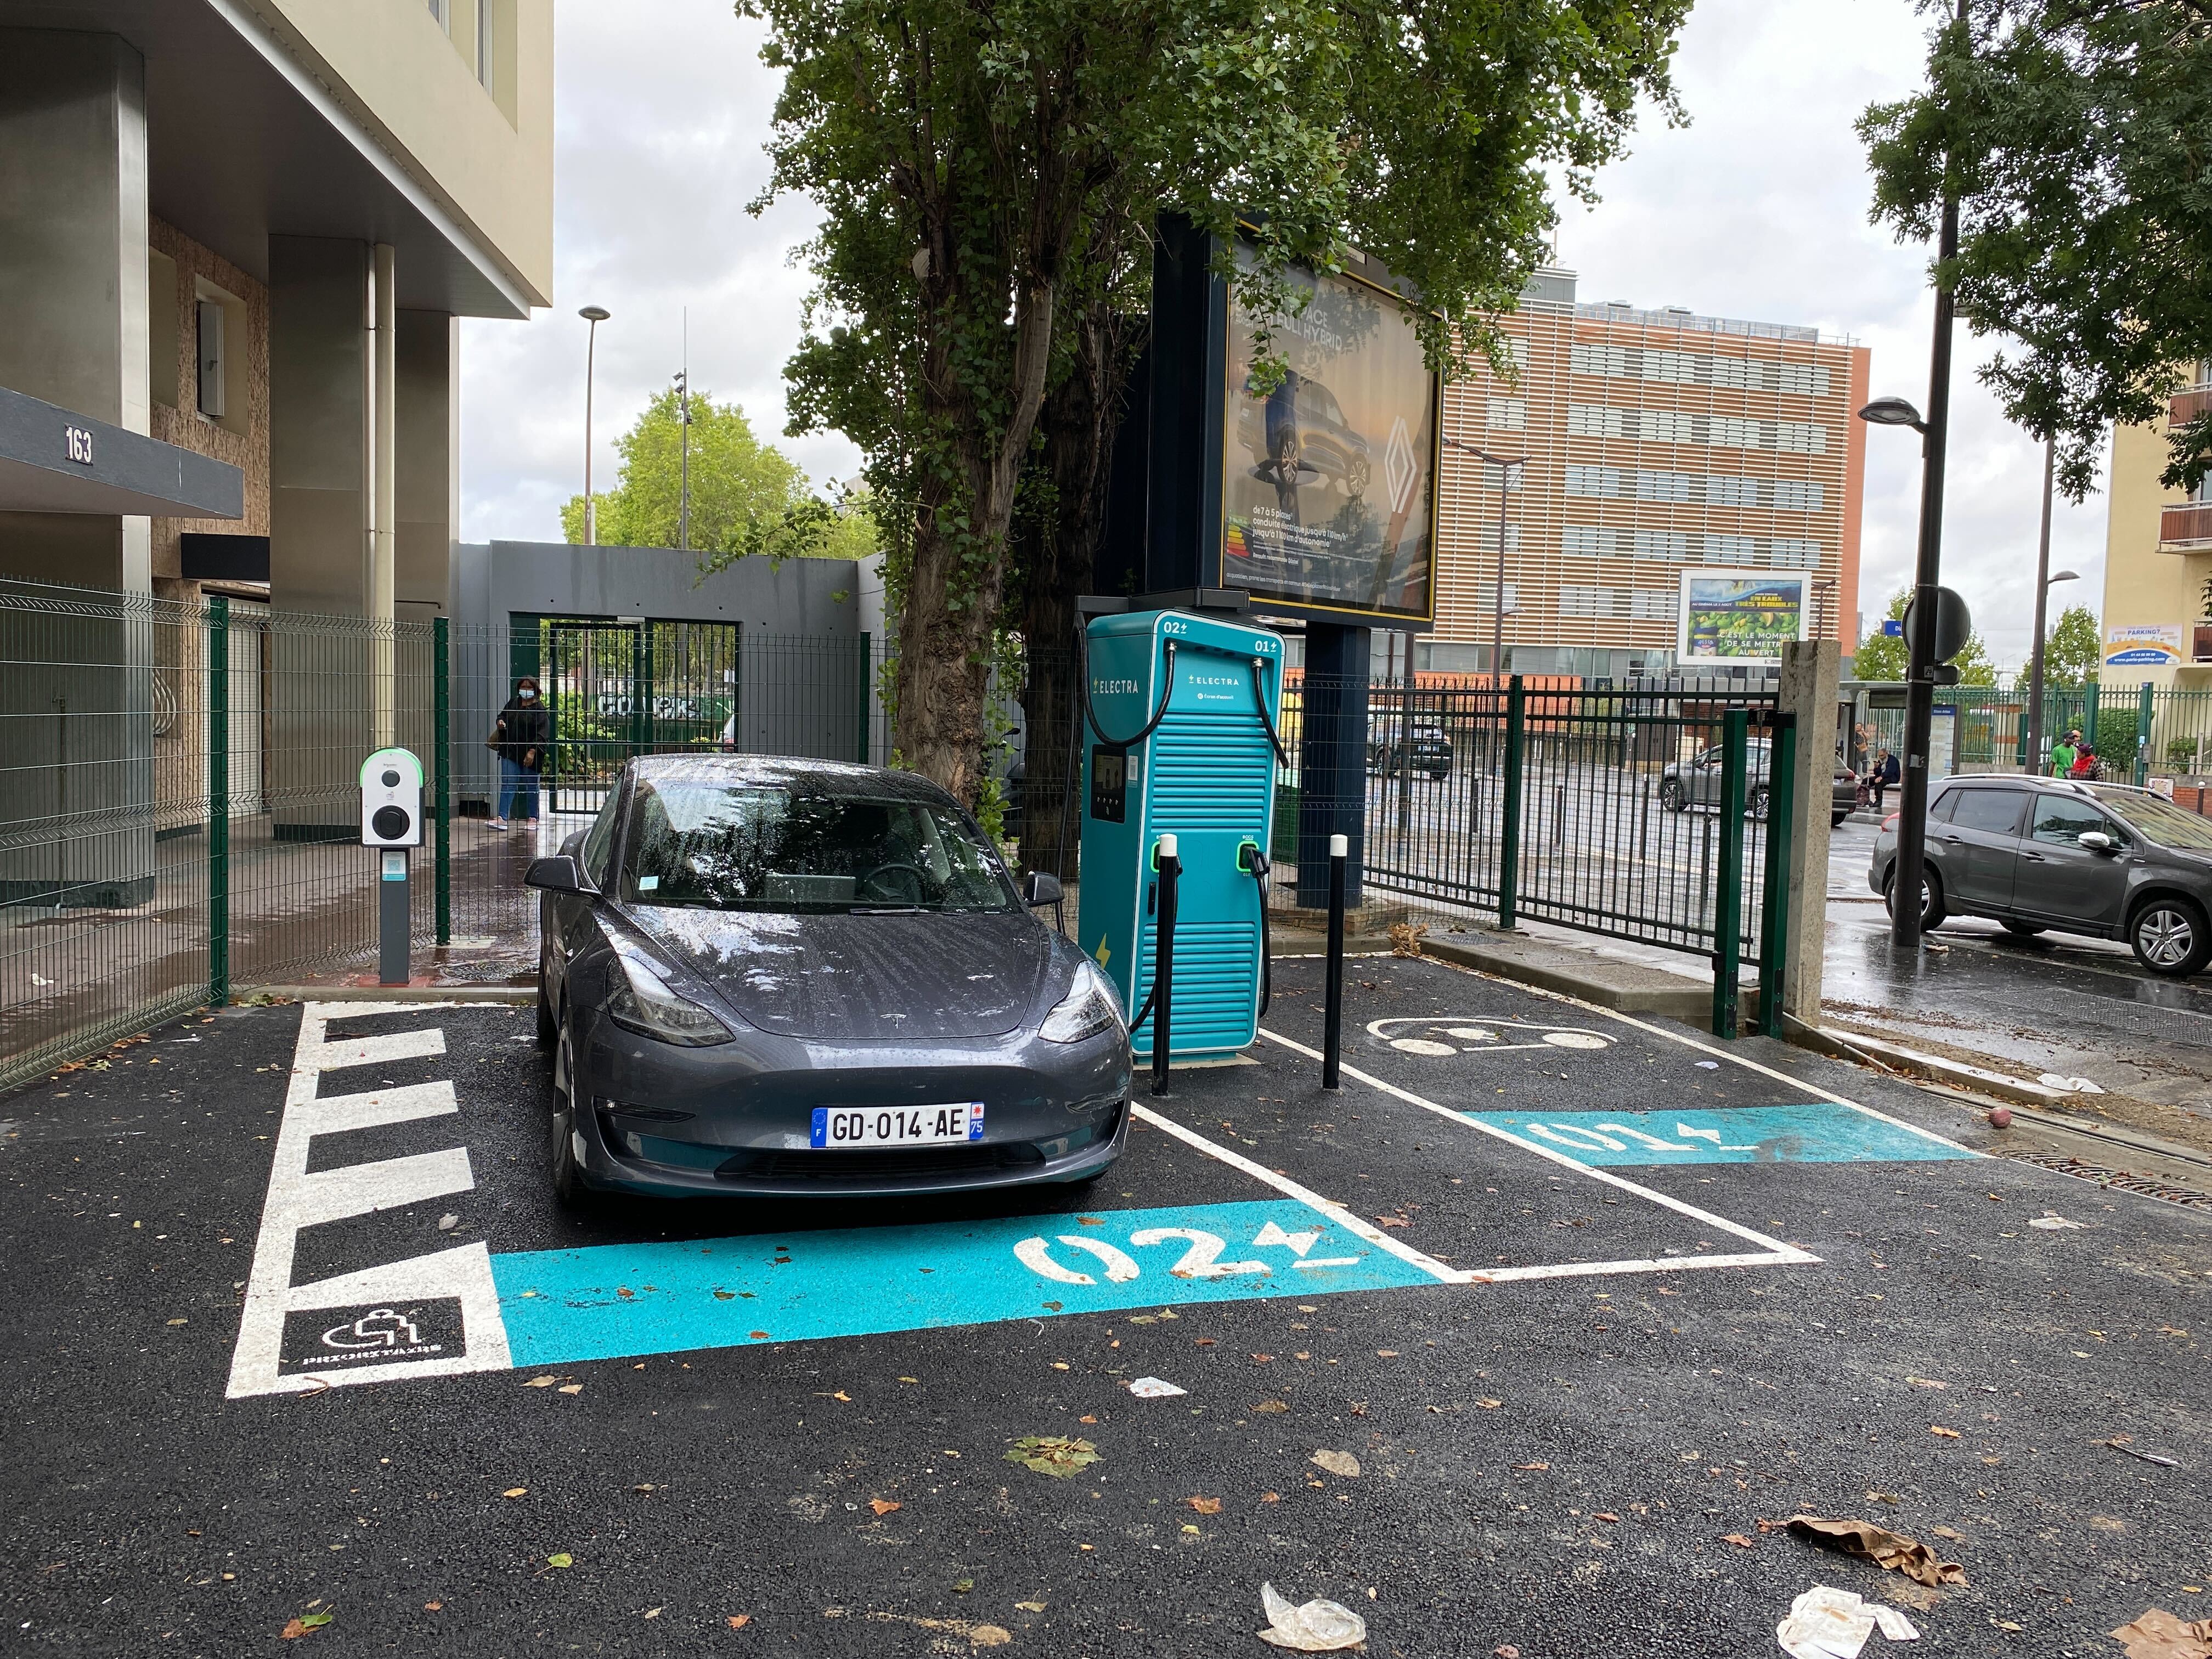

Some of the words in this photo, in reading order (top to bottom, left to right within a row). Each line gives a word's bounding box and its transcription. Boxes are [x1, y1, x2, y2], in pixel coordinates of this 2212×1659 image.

[1303, 323, 1342, 351] HYBRID
[66, 426, 92, 462] 163
[1253, 505, 1261, 515] de
[1261, 507, 1264, 515] 7
[1265, 507, 1269, 516] à
[1271, 509, 1275, 517] 5
[1253, 517, 1280, 528] conduite
[1286, 533, 1294, 542] km
[1164, 622, 1180, 634] 02
[1255, 640, 1269, 652] 01
[1100, 680, 1138, 694] ELECTRA
[1197, 677, 1239, 686] ELECTRA
[832, 1108, 963, 1141] GD-014-AE
[970, 1120, 983, 1133] 75
[816, 1128, 822, 1137] F
[1013, 1228, 1271, 1284] 02
